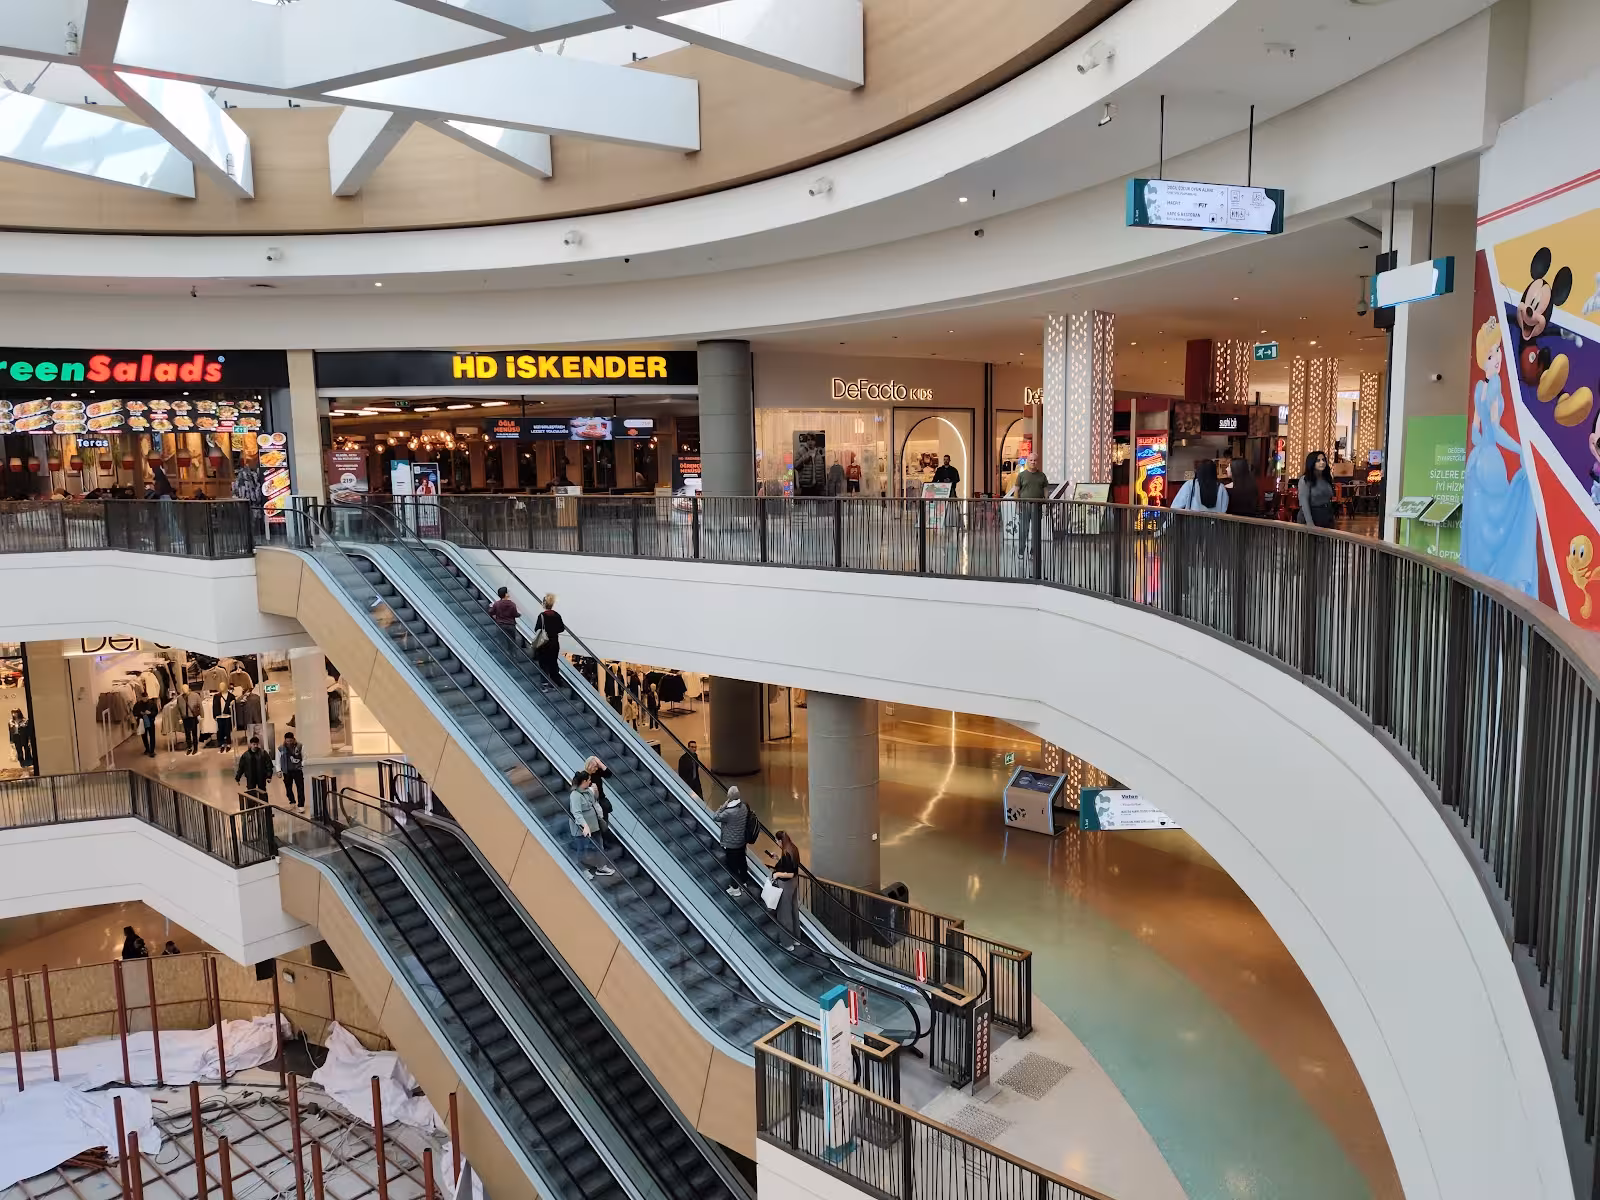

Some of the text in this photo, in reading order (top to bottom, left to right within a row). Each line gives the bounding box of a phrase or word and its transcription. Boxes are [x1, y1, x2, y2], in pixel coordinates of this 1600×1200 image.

[452, 356, 498, 378] HD
[832, 378, 934, 400] DeFacto KIDS
[77, 439, 108, 447] Teras
[1430, 468, 1460, 478] SİZLERE
